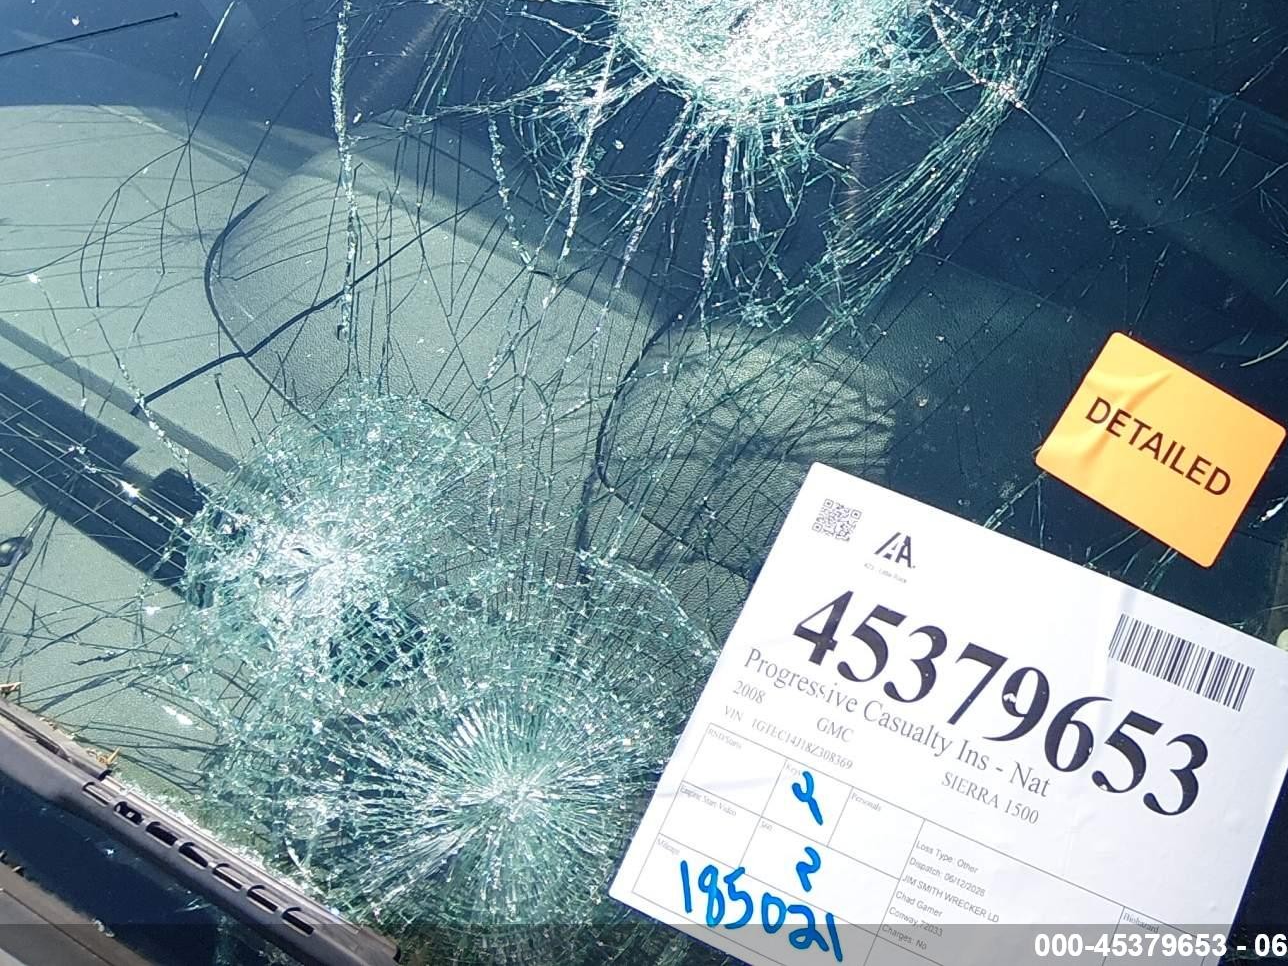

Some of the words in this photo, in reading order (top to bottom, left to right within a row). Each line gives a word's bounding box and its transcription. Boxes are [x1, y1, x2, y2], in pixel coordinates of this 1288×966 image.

[1085, 396, 1231, 496] DETAILED
[724, 705, 744, 722] VIN
[732, 680, 767, 704] 2008
[816, 716, 854, 743] GMC
[941, 771, 999, 809] SIERRA
[1004, 799, 1039, 825] 1500
[744, 648, 858, 713] Progressive
[863, 700, 953, 757] Casualty
[956, 739, 990, 771] Ins
[1010, 761, 1050, 797] Nat
[793, 590, 1208, 816] 45379653
[680, 860, 843, 962] 185021
[895, 891, 916, 905] Chad
[916, 939, 927, 951] No
[917, 880, 944, 898] SMITH
[944, 892, 987, 918] WRECKER
